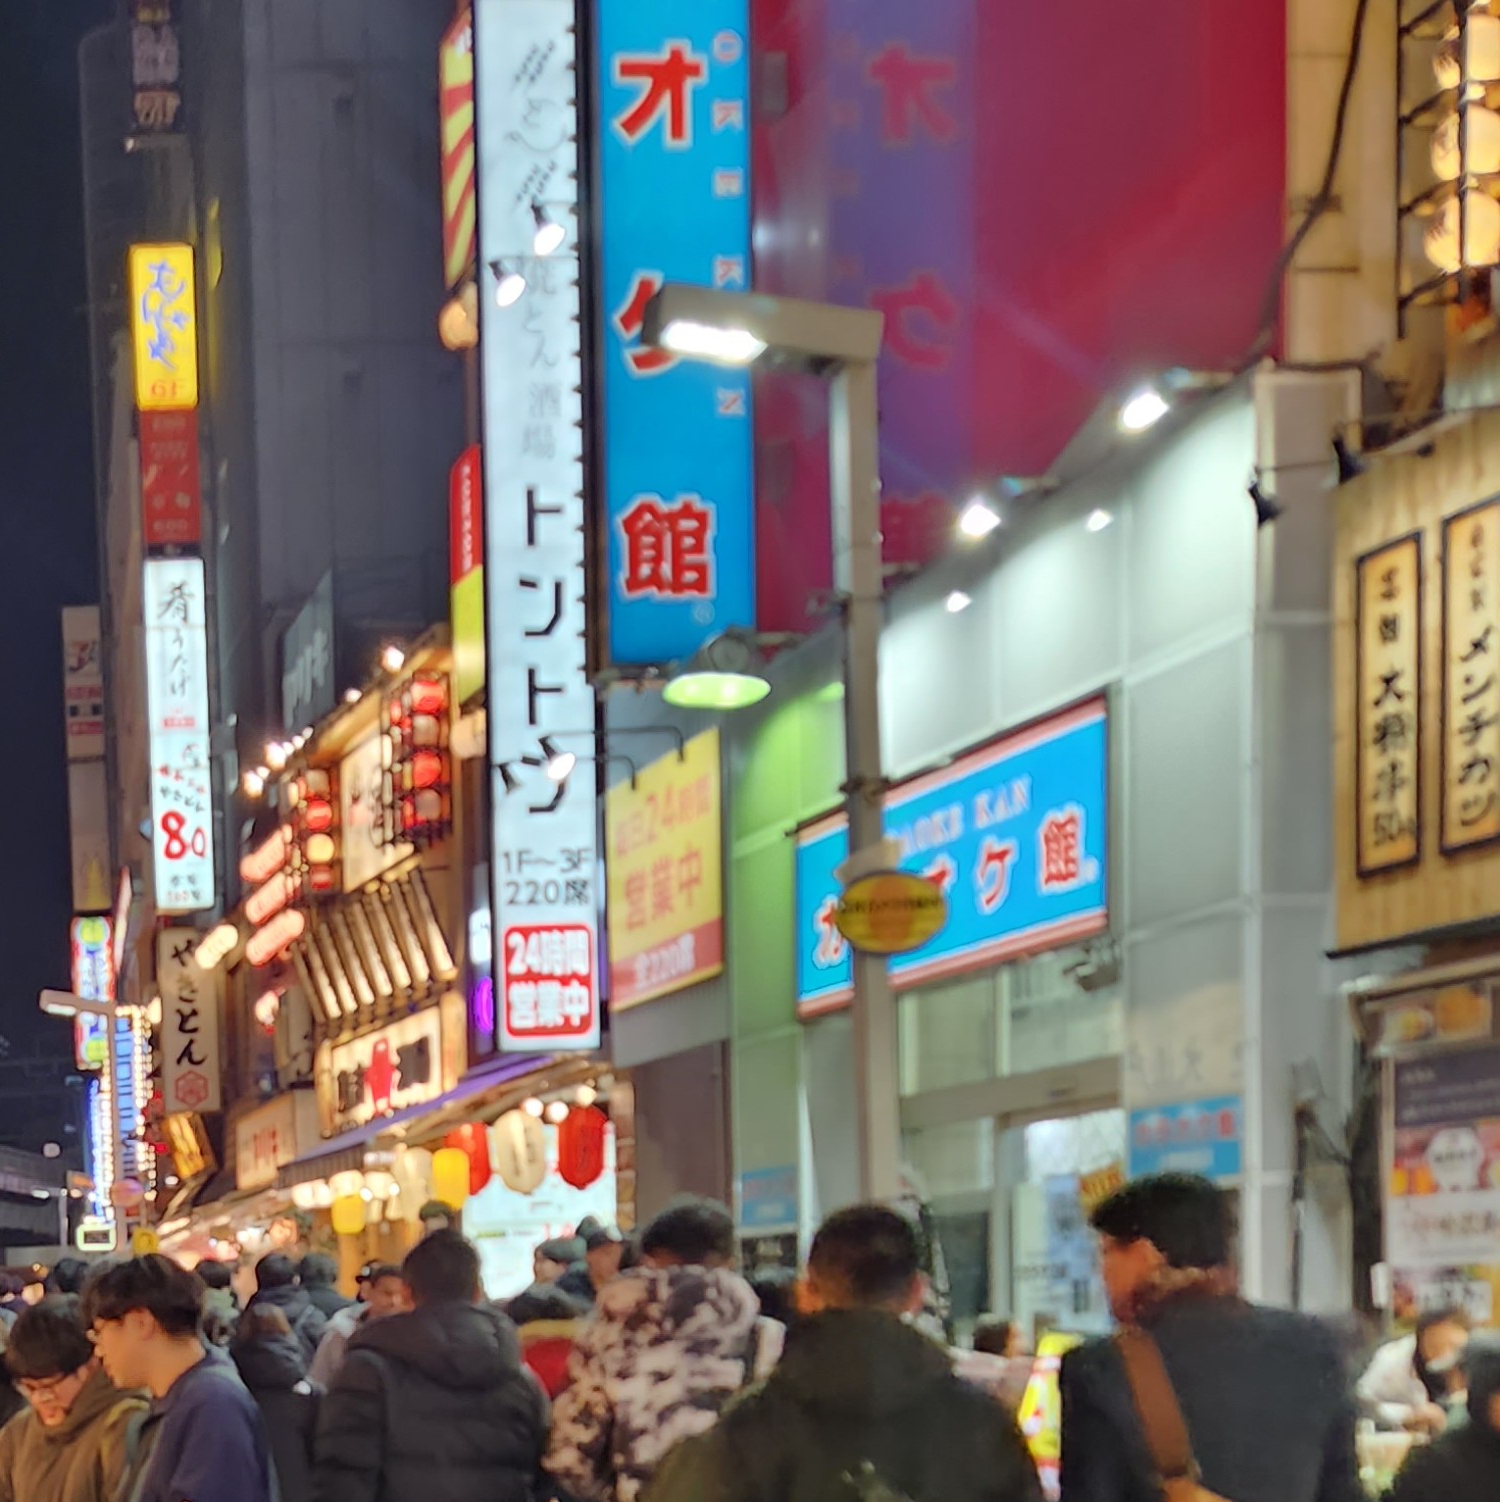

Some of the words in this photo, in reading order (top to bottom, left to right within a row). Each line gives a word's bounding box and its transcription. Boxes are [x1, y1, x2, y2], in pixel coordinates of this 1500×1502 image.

[714, 255, 746, 417] KN
[518, 487, 568, 814] トントン
[973, 776, 1033, 829] KAN
[505, 880, 590, 906] 220席
[624, 846, 705, 931] 営業中
[506, 929, 590, 977] 24時間
[507, 980, 590, 1029] 営業中
